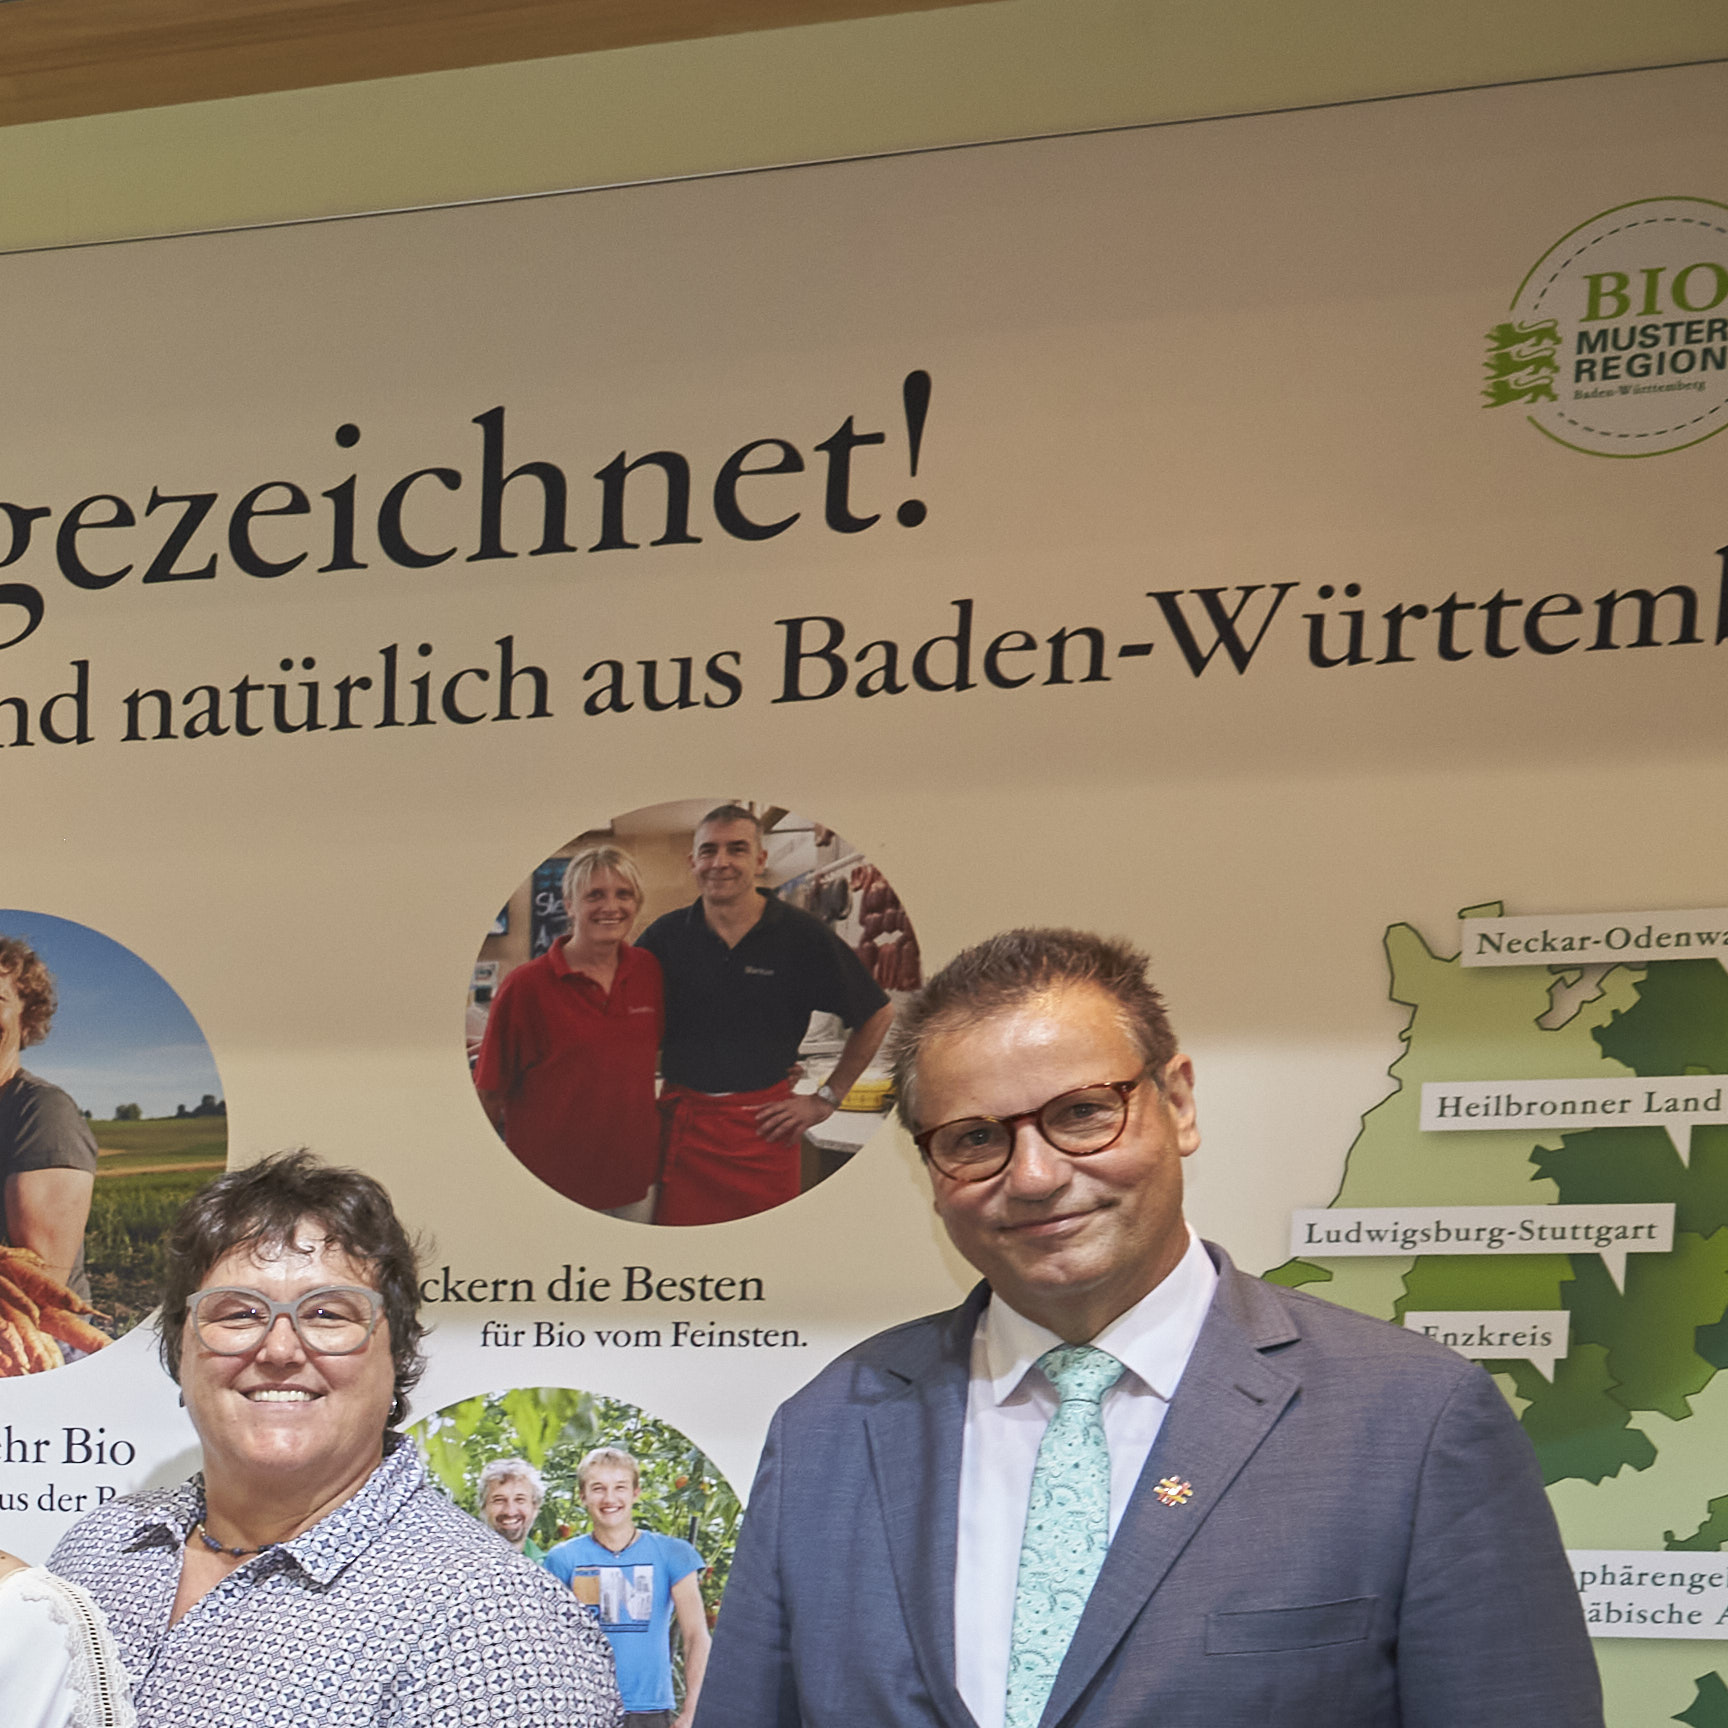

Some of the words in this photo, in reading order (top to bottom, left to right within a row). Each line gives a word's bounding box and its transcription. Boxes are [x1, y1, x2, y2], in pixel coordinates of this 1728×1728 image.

[1578, 262, 1728, 323] BIO
[1575, 318, 1728, 356] MUSTER
[1574, 345, 1728, 384] REGION
[1573, 380, 1707, 400] Baden-Württemberg
[121, 636, 553, 744] natürlich
[581, 645, 743, 718] aus
[771, 545, 1728, 706] Baden-Württem
[1436, 1089, 1631, 1119] Heilbronner
[1643, 1088, 1722, 1114] Land
[1305, 1219, 1658, 1250] Ludwigsburg-Stuttgart
[419, 1265, 537, 1303] ckern
[547, 1265, 611, 1302] die
[623, 1265, 767, 1302] Besten
[481, 1320, 526, 1347] für
[532, 1321, 586, 1348] Bio
[594, 1332, 662, 1348] vom
[670, 1321, 808, 1348] Feinsten.
[61, 1427, 136, 1466] Bio
[37, 1483, 88, 1512] der
[1577, 1564, 1728, 1595] phärenge
[1587, 1601, 1703, 1625] äbische
